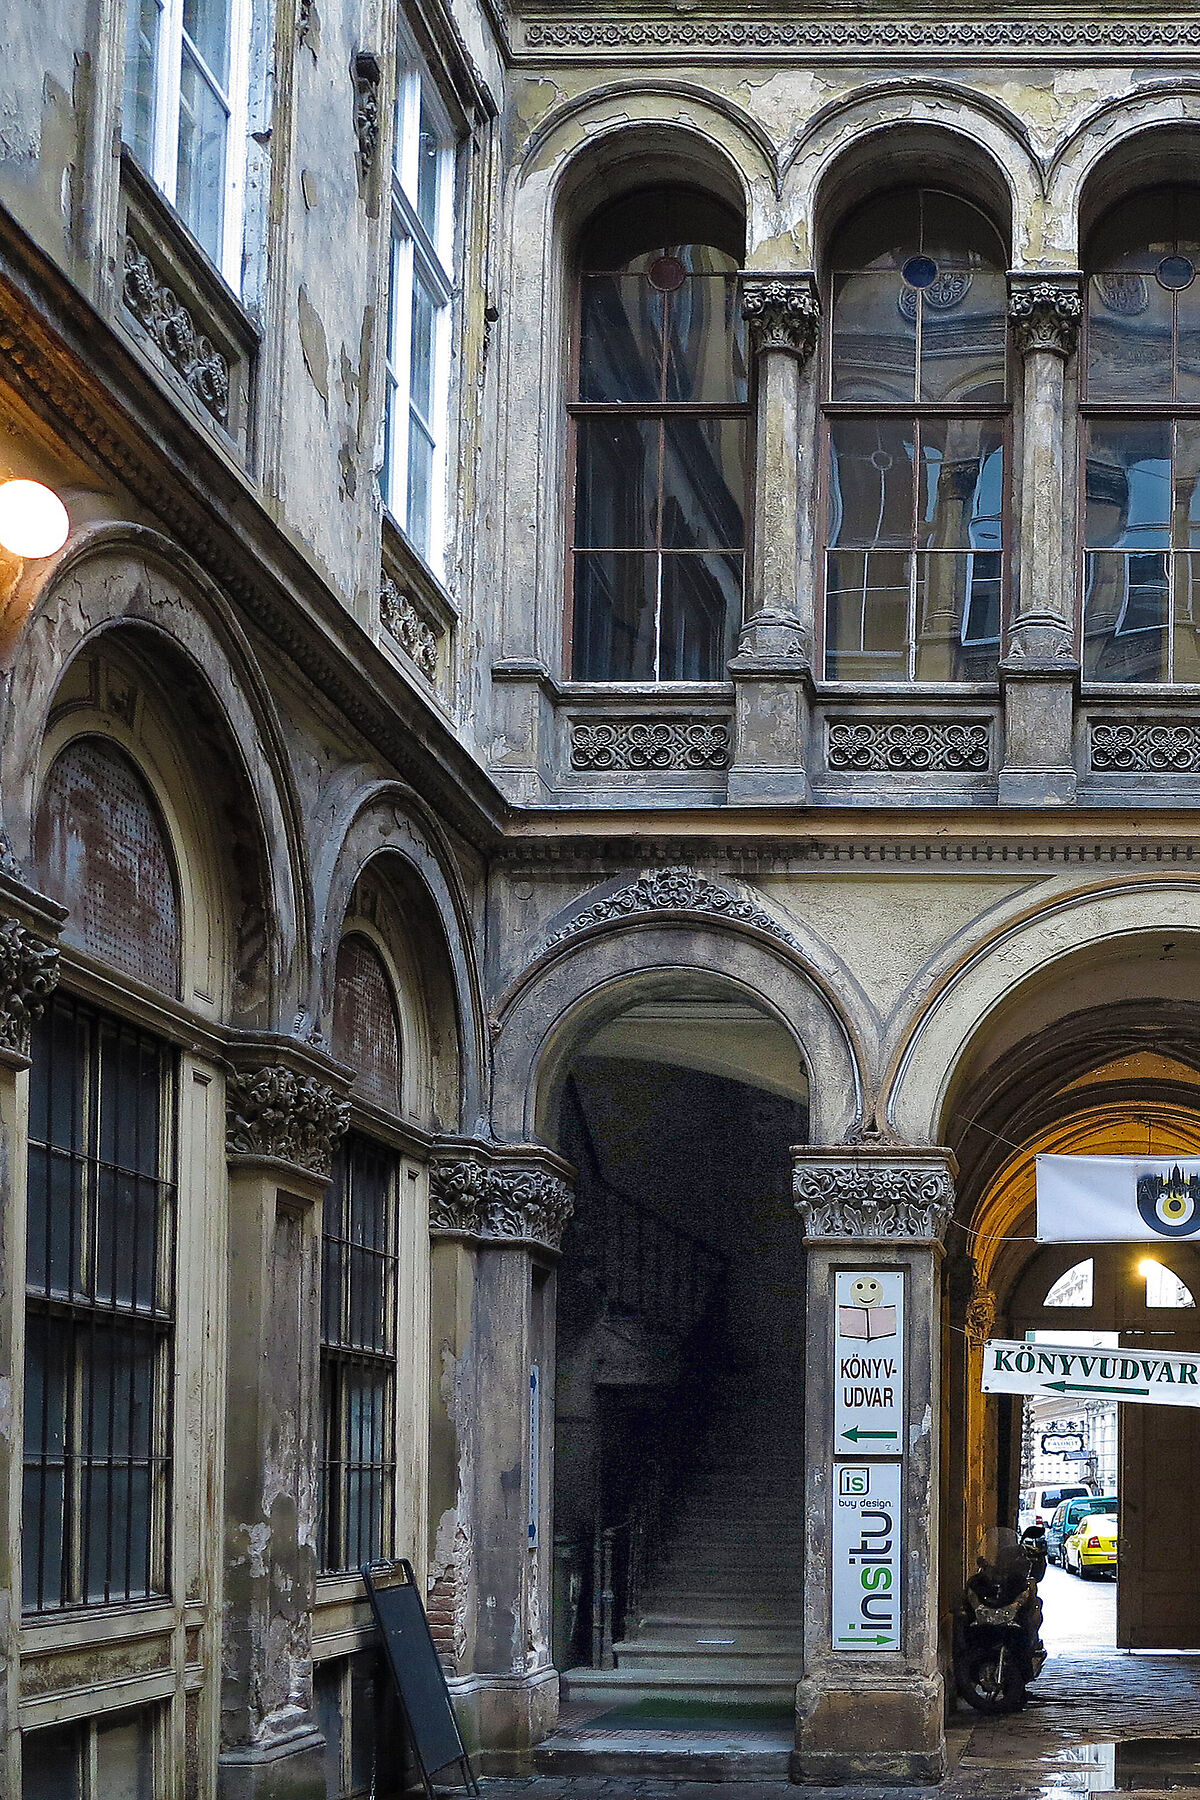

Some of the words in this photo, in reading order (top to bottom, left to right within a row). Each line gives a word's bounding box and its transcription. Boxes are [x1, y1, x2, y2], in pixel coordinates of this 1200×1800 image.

[840, 1353, 897, 1379] KÖNYV-
[992, 1344, 1198, 1385] KÖNYVUDVAR
[843, 1387, 894, 1408] UDVAR
[846, 1471, 864, 1491] is
[839, 1499, 857, 1509] buy
[849, 1510, 893, 1630] insitu
